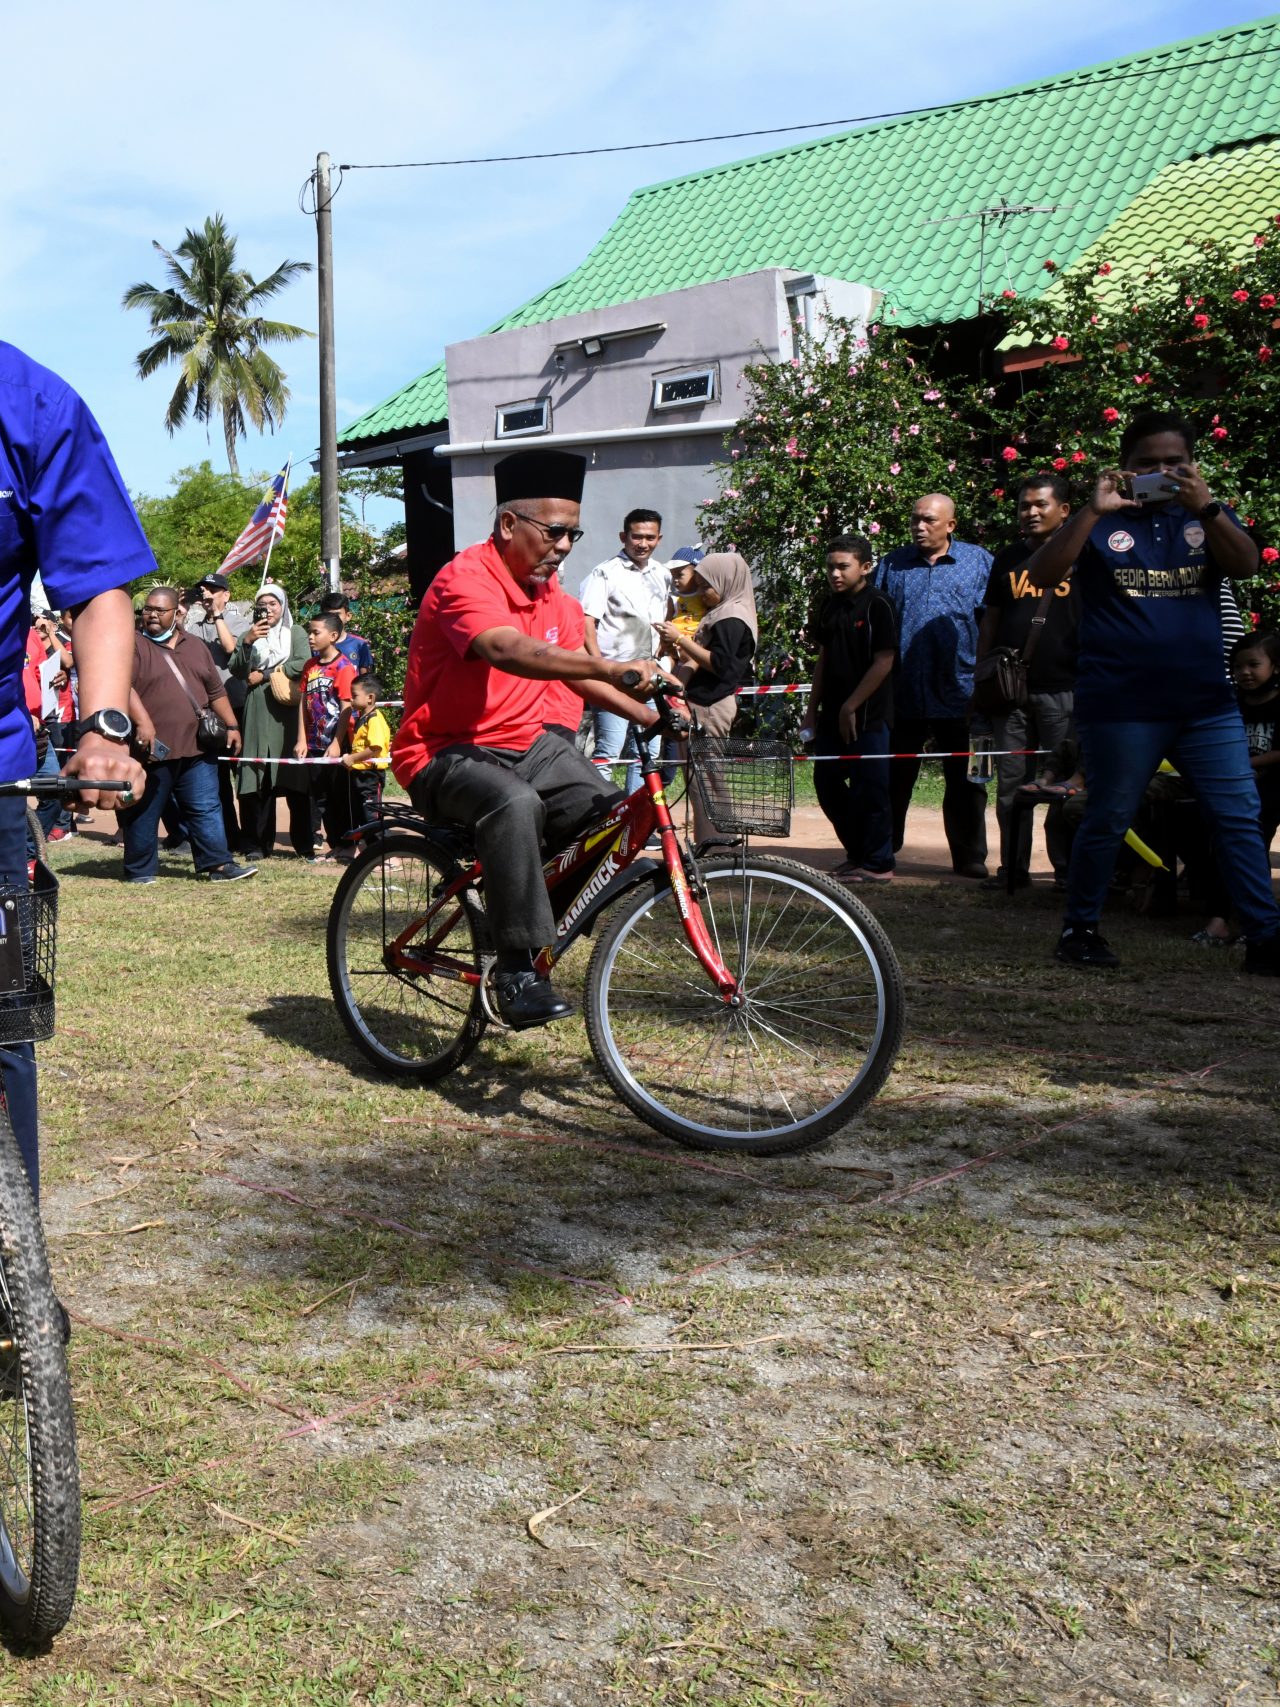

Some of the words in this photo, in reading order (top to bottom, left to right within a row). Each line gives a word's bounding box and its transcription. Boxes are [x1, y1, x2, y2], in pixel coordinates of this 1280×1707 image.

[1009, 569, 1070, 599] VAS
[1114, 568, 1146, 588] SEDIA
[1147, 565, 1204, 588] BERKHIDM
[556, 853, 621, 938] SAMROCK
